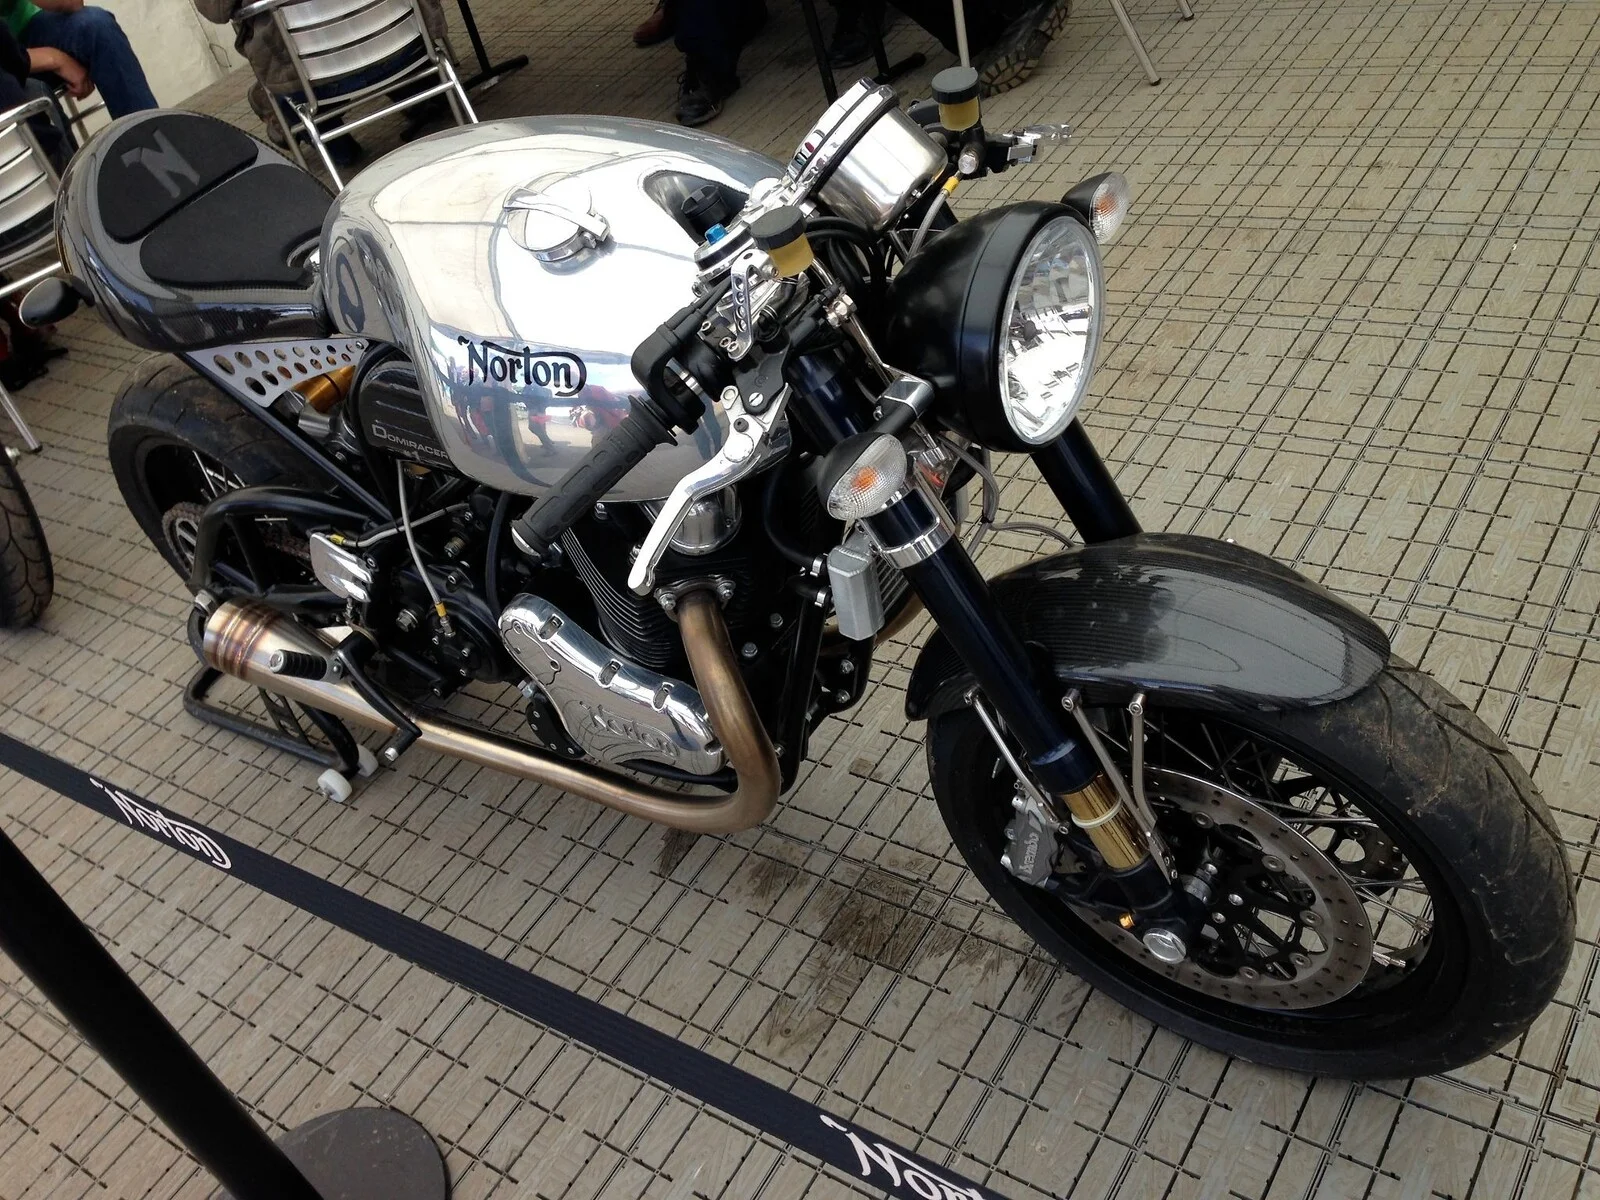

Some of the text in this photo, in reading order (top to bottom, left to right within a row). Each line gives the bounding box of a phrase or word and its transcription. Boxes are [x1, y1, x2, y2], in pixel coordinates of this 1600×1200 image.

[457, 335, 588, 397] Norton
[371, 424, 449, 460] DOMIRACER
[579, 700, 682, 765] Norton
[89, 779, 232, 869] Norton
[1019, 831, 1040, 874] brembo
